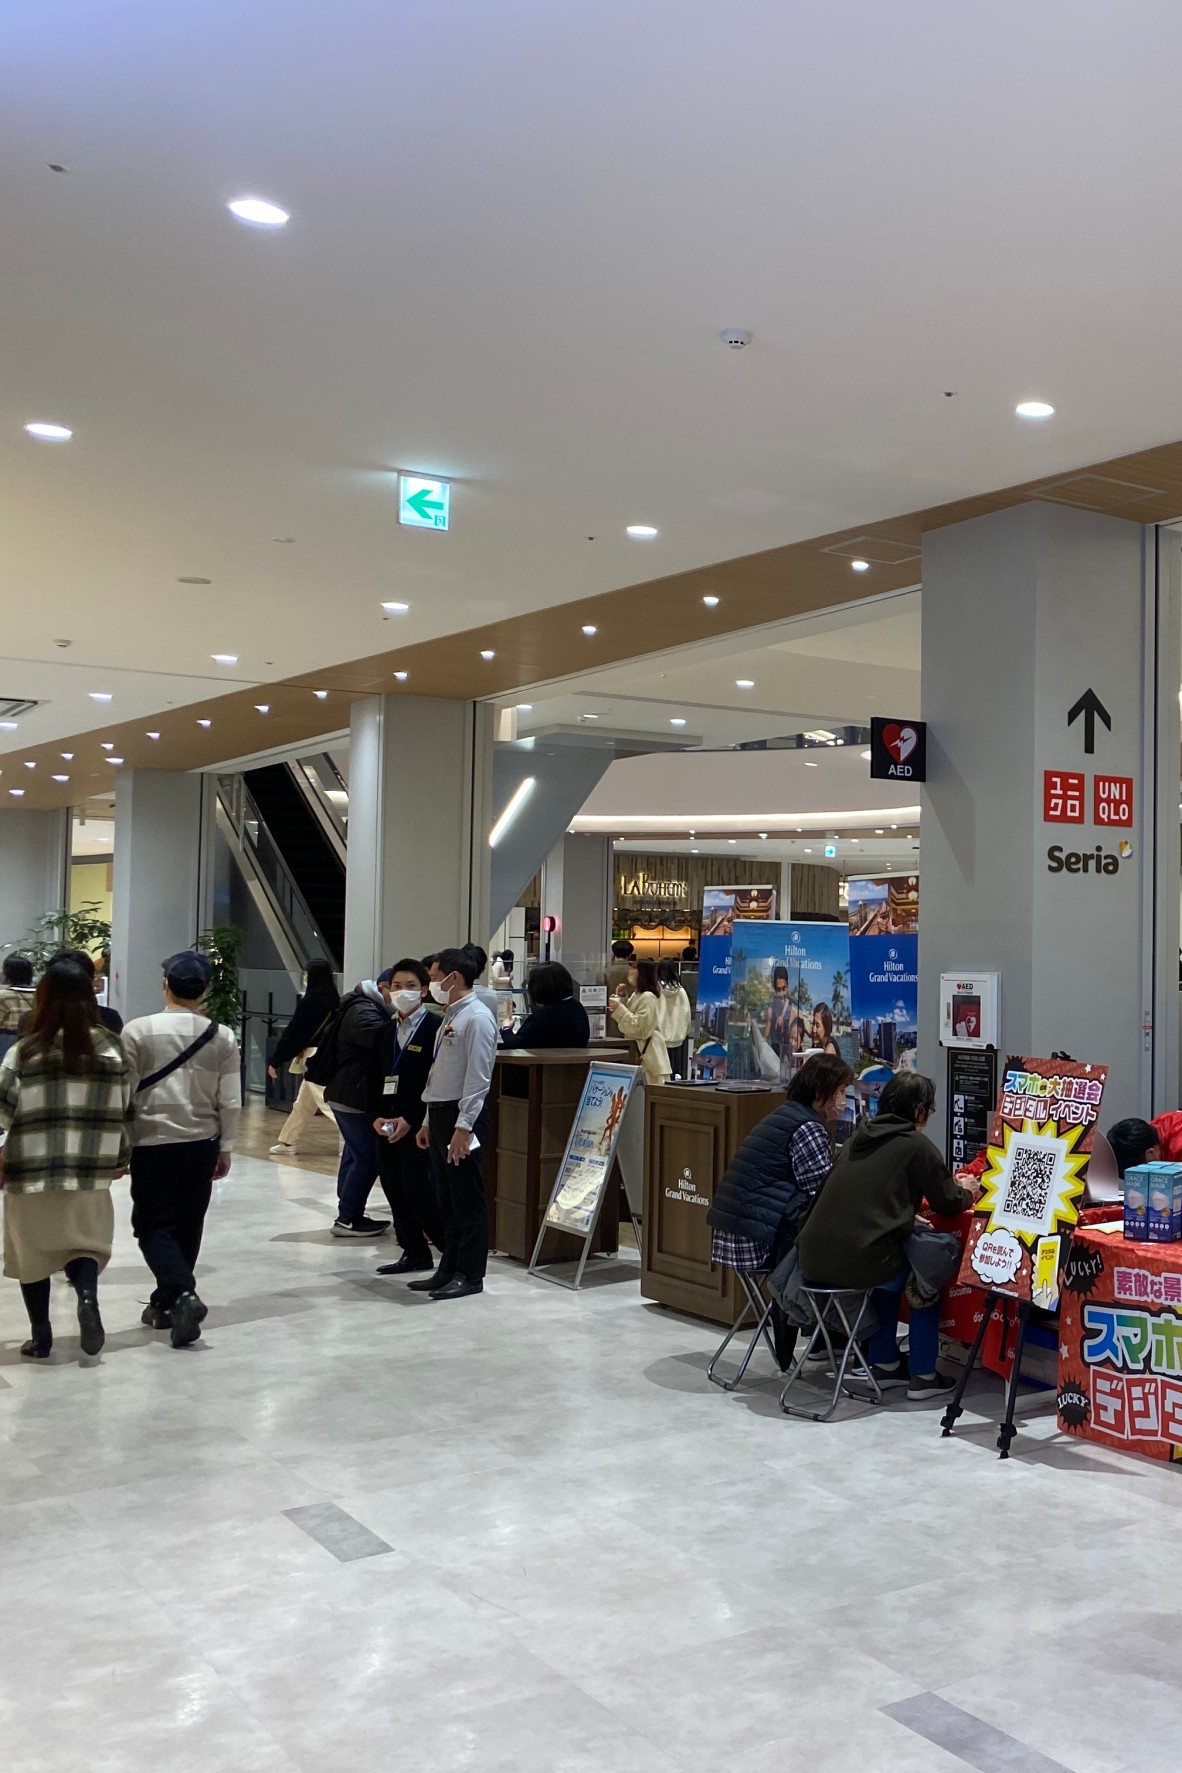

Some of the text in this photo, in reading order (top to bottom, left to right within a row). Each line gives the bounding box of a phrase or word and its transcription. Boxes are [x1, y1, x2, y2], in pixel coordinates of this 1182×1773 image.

[888, 764, 913, 777] AED
[1047, 845, 1120, 875] Seria
[784, 945, 806, 957] Hilton
[883, 961, 904, 972] Hilton
[869, 972, 918, 983] Grand Vacations
[678, 1179, 696, 1191] Hilton
[665, 1187, 709, 1206] Grand Vacations
[1058, 1391, 1089, 1409] LUCKY
